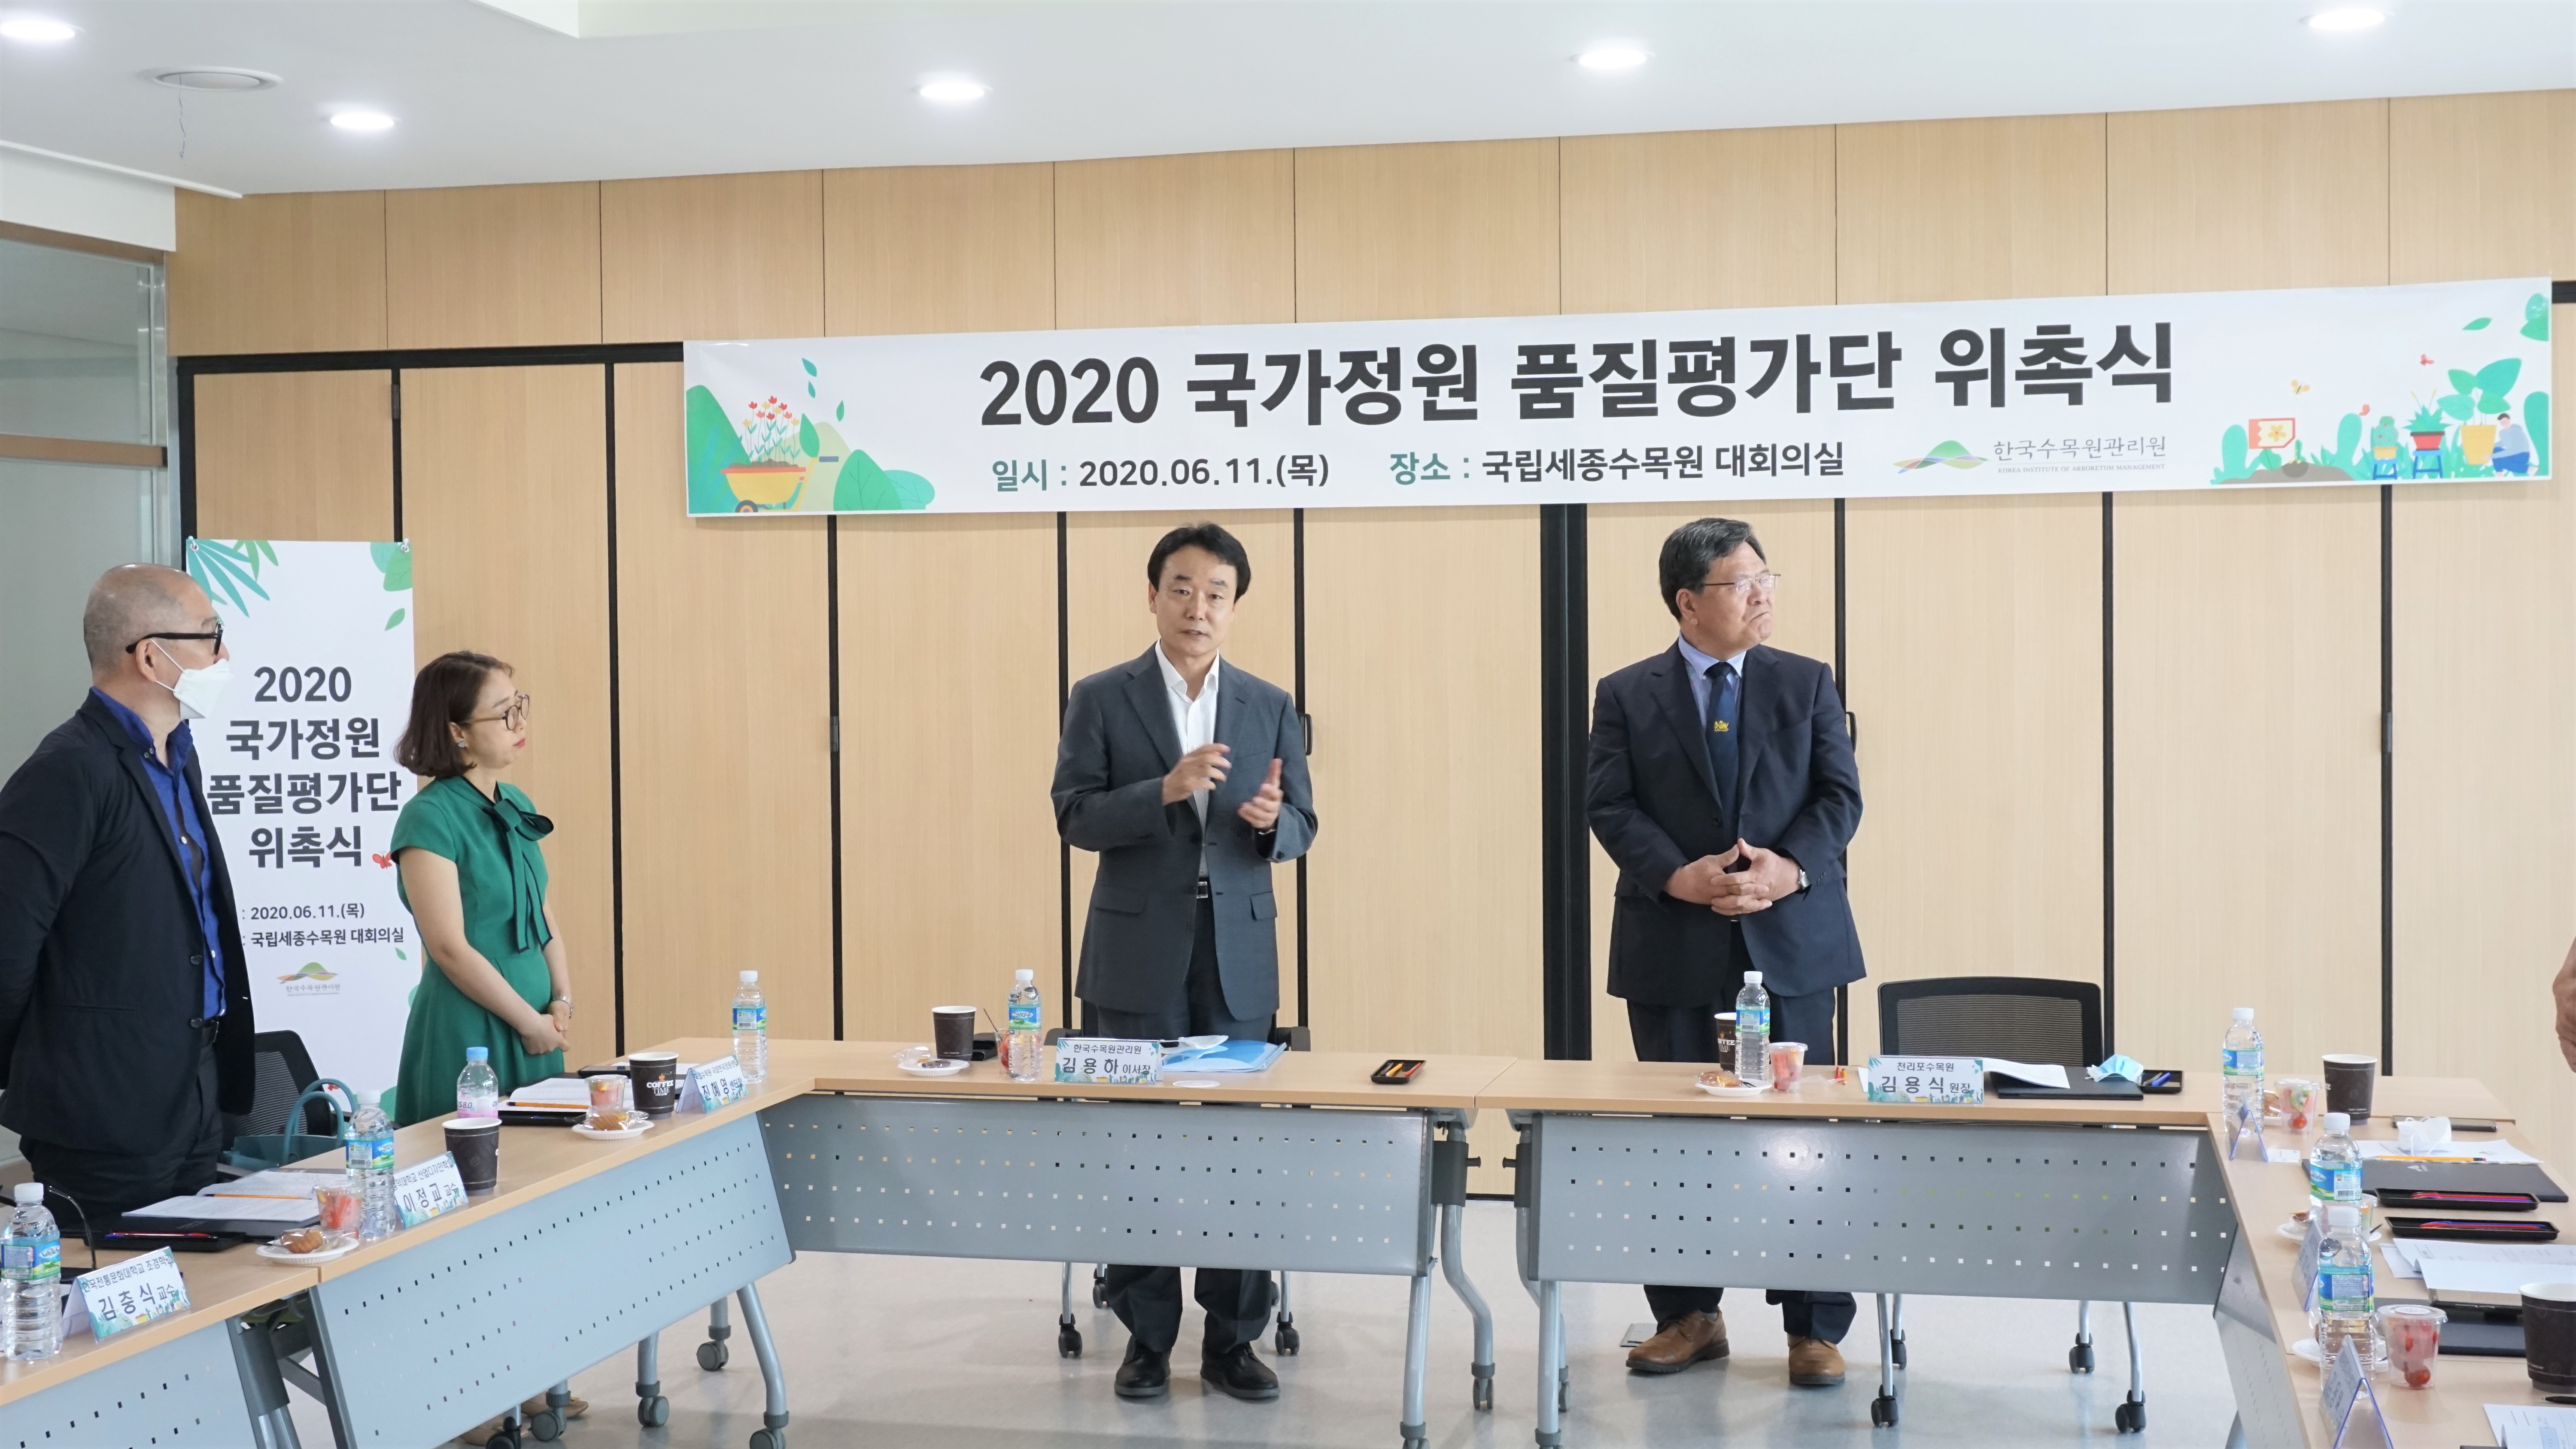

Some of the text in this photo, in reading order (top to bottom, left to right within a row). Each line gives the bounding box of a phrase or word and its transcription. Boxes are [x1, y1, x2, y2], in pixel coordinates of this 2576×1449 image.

[980, 320, 2171, 427] 2020 국가정원 품질평가단 위촉식
[1993, 436, 2166, 461] 한국수목원관리원
[992, 459, 1047, 492] 일시
[1080, 454, 1329, 488] 2020.06.11.(목)
[1390, 452, 1451, 485] 장소
[1482, 445, 1703, 483] 국립세종수목원
[1716, 440, 1846, 477] 대회의실
[254, 666, 352, 703] 2020
[226, 717, 380, 761] 국가정원
[207, 771, 402, 815] 품질평가단
[249, 825, 361, 869] 위촉식
[251, 902, 365, 920] 2020.06.11.(목)
[251, 928, 346, 948] 국립세종수목원
[351, 927, 404, 943] 대회의실
[1074, 1043, 1142, 1055] 한국수목원관리원
[1123, 1064, 1151, 1075] 이사장
[1897, 1062, 1954, 1072] 천리포수목원
[647, 1080, 674, 1088] COFFEE
[1950, 1082, 1971, 1094] 원장
[444, 1182, 459, 1197] 교수
[82, 1263, 145, 1293] 한국전통문화대학교
[156, 1284, 175, 1300] 교수
